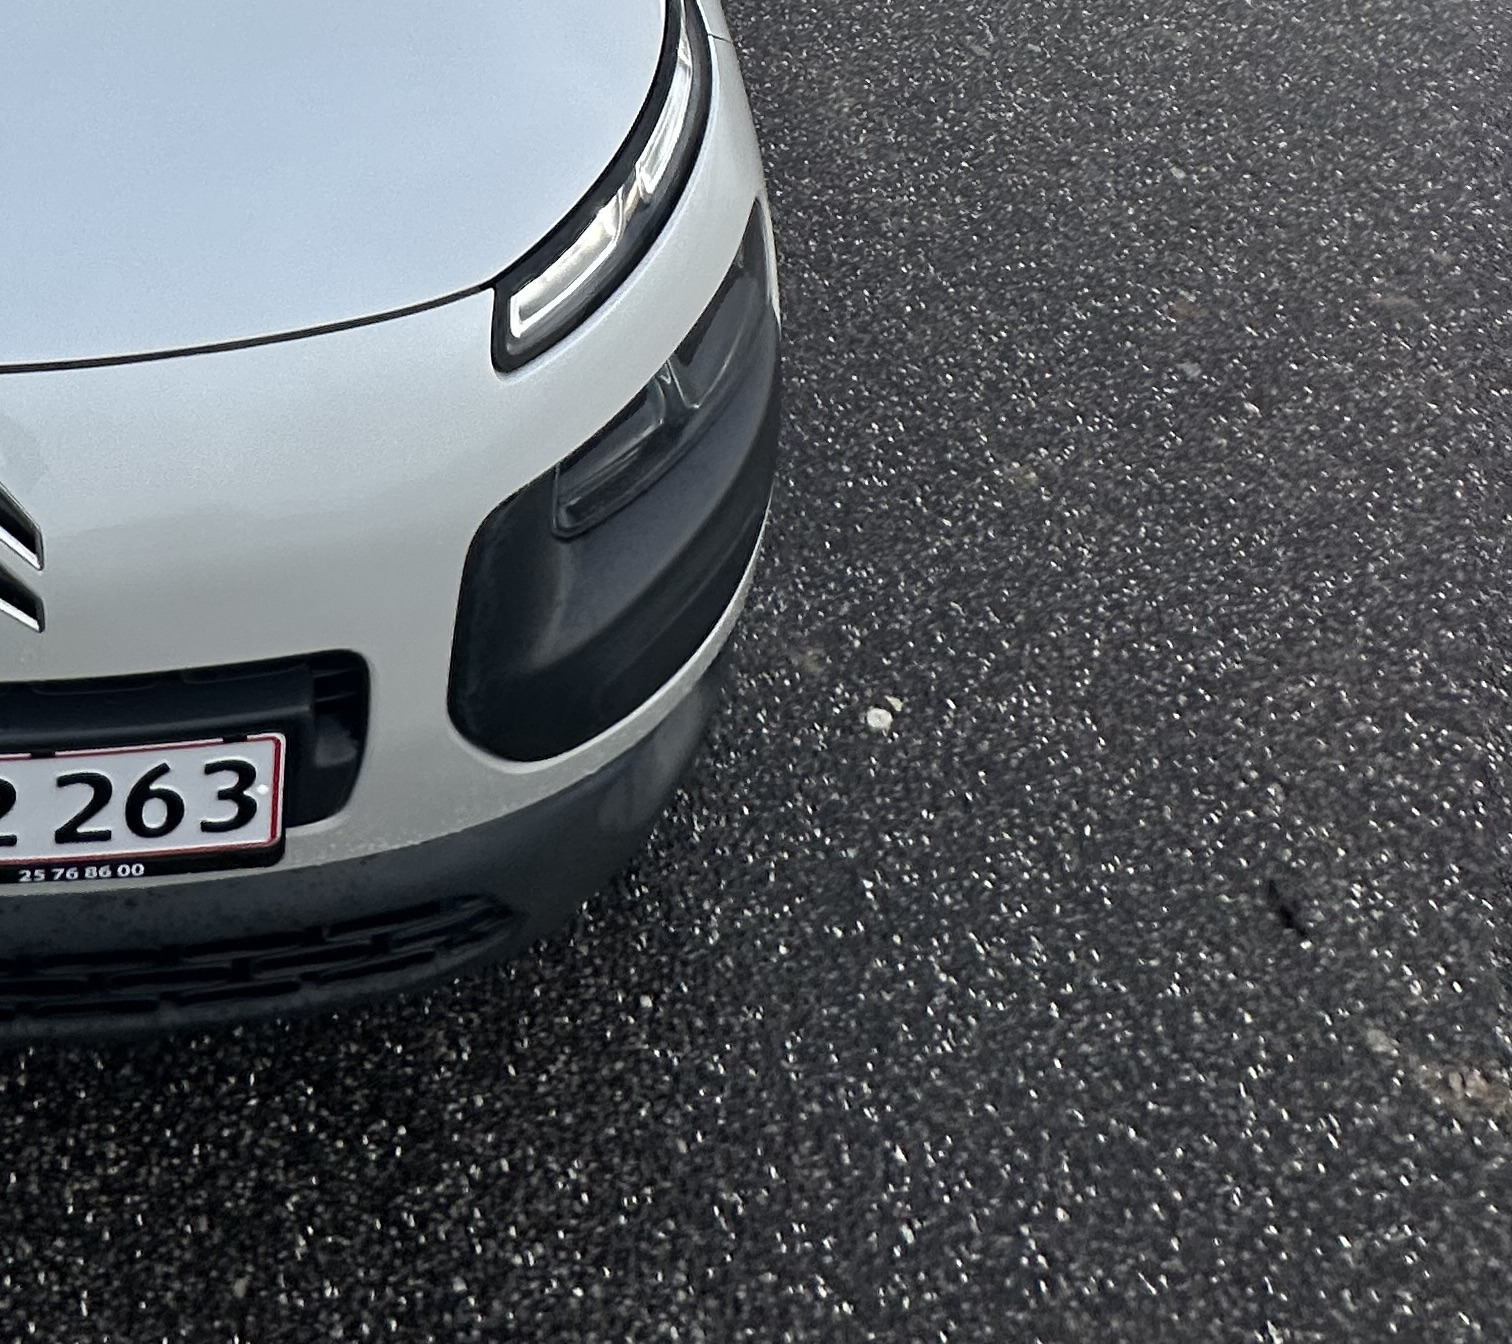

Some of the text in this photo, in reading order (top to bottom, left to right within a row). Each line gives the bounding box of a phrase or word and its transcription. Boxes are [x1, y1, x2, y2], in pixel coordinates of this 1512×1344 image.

[54, 759, 259, 846] 263
[18, 869, 45, 883] 25
[51, 867, 78, 881] 76
[85, 865, 111, 879] 86
[117, 863, 145, 877] 00
